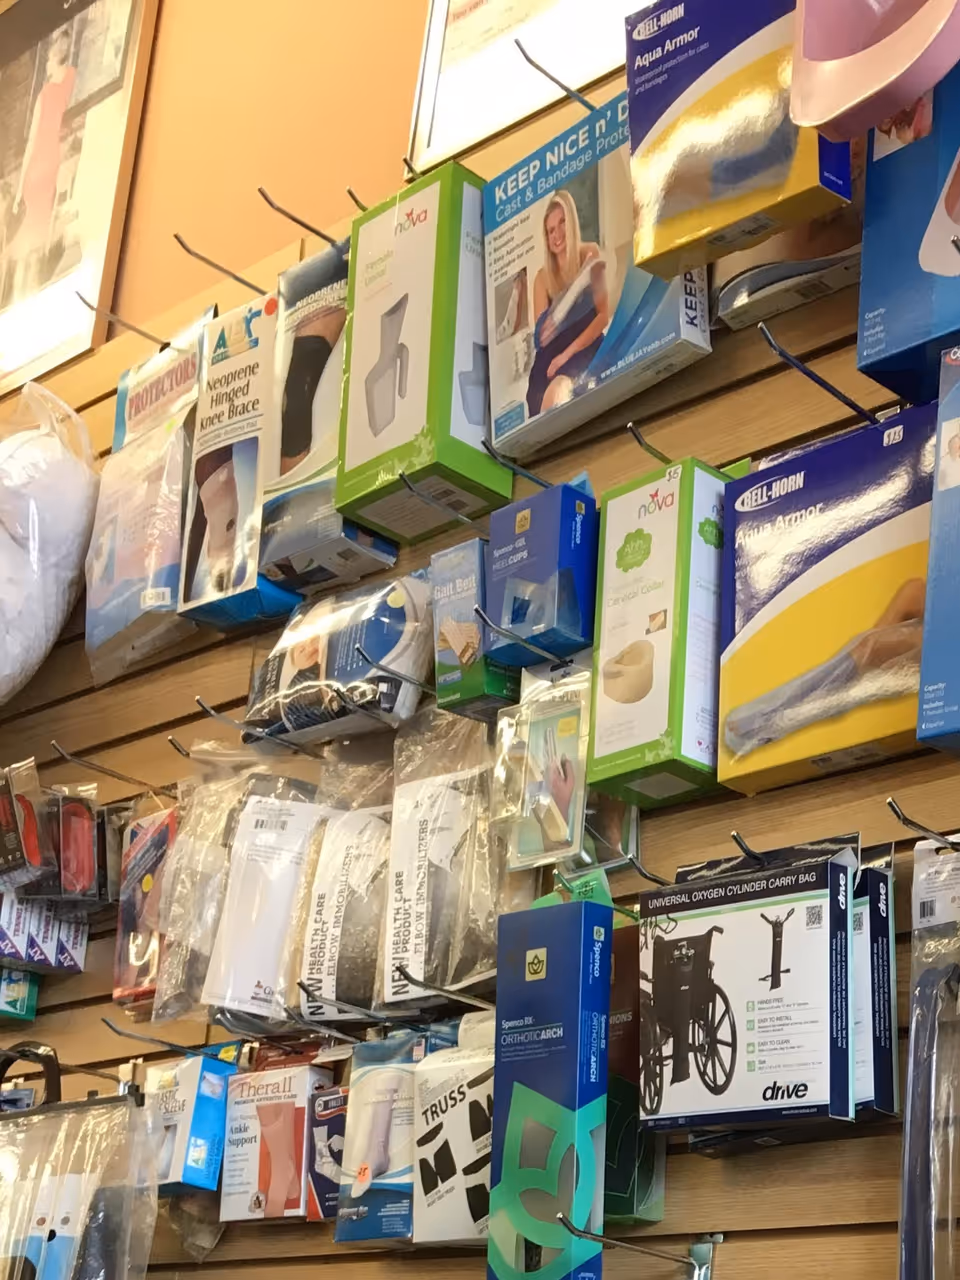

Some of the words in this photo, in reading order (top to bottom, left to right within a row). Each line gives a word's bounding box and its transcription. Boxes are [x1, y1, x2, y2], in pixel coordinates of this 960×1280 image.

[636, 2, 685, 38] BELL-HORN
[634, 47, 662, 70] Aqua
[664, 26, 700, 54] Armor
[494, 160, 541, 205] KEEP
[546, 126, 589, 172] NICE
[495, 199, 521, 223] Cast
[525, 186, 534, 201] &
[537, 149, 593, 194] Bandage
[395, 208, 428, 236] nova
[684, 270, 699, 328] KEEP
[127, 352, 198, 421] PROTECTORS
[207, 361, 260, 393] Neoprene
[210, 380, 250, 409] Hinged
[200, 409, 225, 433] Knee
[227, 397, 260, 420] Brace
[638, 490, 675, 519] nova
[740, 471, 806, 507] BELL-HORN
[575, 513, 584, 545] Spenco
[733, 520, 773, 548] Aqua
[775, 502, 824, 532] Armor
[434, 582, 455, 600] Gait
[455, 574, 476, 593] Belt
[415, 818, 430, 912] IMMOBILIZERS
[394, 870, 405, 908] CARE
[648, 890, 691, 910] UNIVERSAL
[692, 886, 726, 904] OXYGEN
[726, 880, 767, 899] CYLINDER
[767, 875, 797, 894] CARRY
[798, 871, 817, 888] BAG
[837, 872, 848, 911] drive
[879, 881, 888, 919] drive
[314, 892, 327, 927] CARE
[401, 896, 413, 954] PRODUCT
[315, 920, 329, 975] PRODUCT
[391, 910, 403, 956] HEALTH
[308, 929, 323, 976] HEALTH
[593, 941, 603, 978] Spenco
[501, 1018, 524, 1030] Spenco
[501, 1027, 564, 1046] ORTHOTICARCH
[239, 1076, 294, 1098] Therall
[421, 1084, 468, 1126] TRUSS
[762, 1080, 809, 1103] drive
[228, 1134, 258, 1149] Support
[229, 1123, 250, 1135] Ankle
